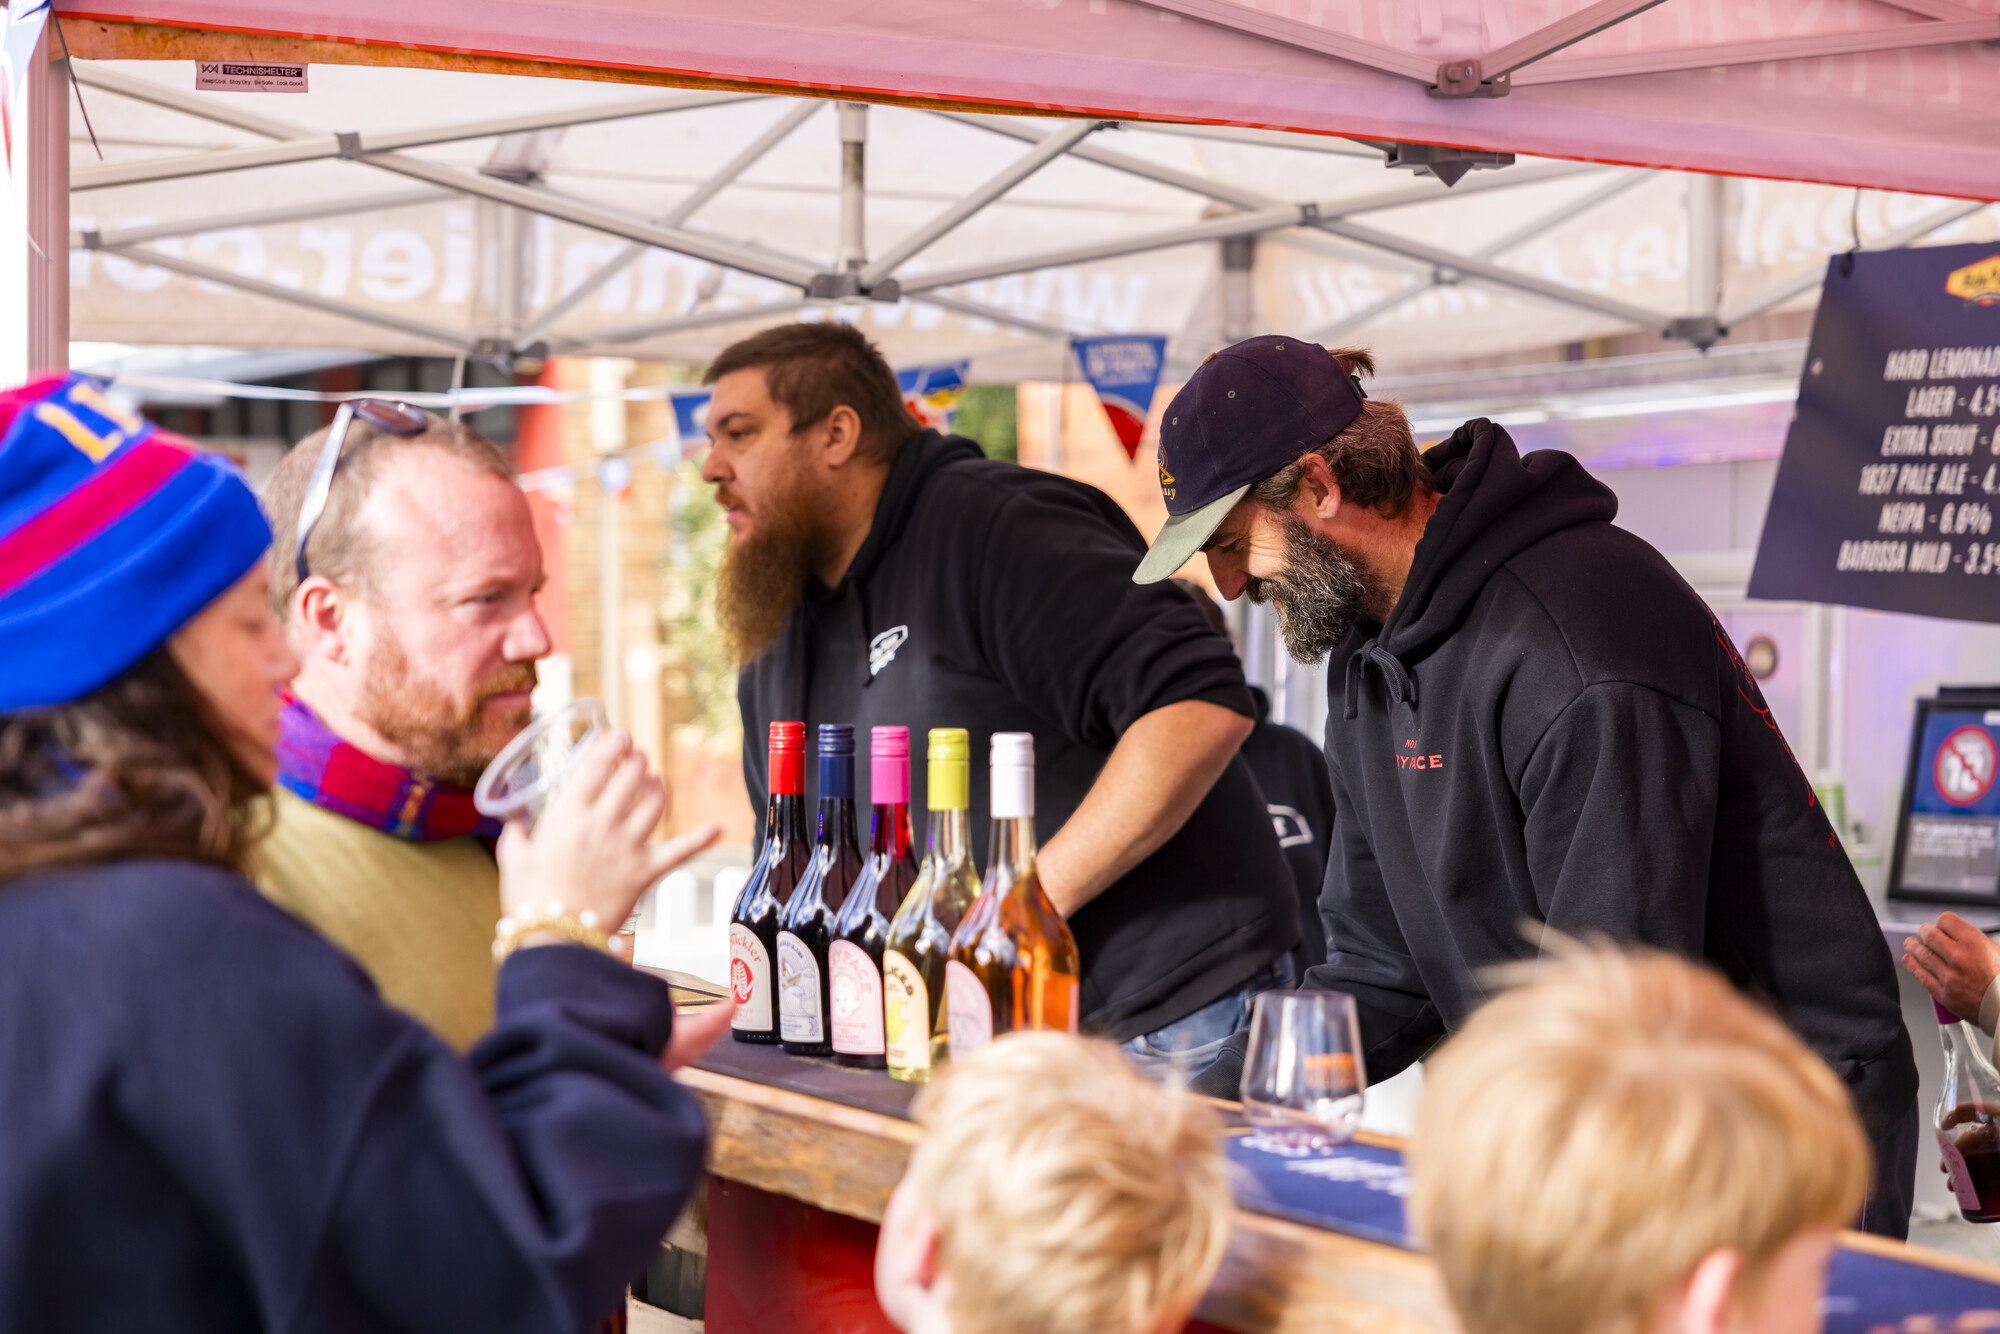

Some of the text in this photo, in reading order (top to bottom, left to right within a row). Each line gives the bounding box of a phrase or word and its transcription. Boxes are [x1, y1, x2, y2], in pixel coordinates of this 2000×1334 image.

[1904, 385, 1957, 418] LAGER
[1880, 424, 1928, 456] EXTRA
[1928, 423, 1979, 456] STOUT
[1896, 463, 1938, 495] PALE
[1935, 463, 1969, 495] ALE
[1877, 502, 1926, 534] NEIPA
[1836, 539, 1907, 572] BAROSSA
[1907, 540, 1952, 573] MILD
